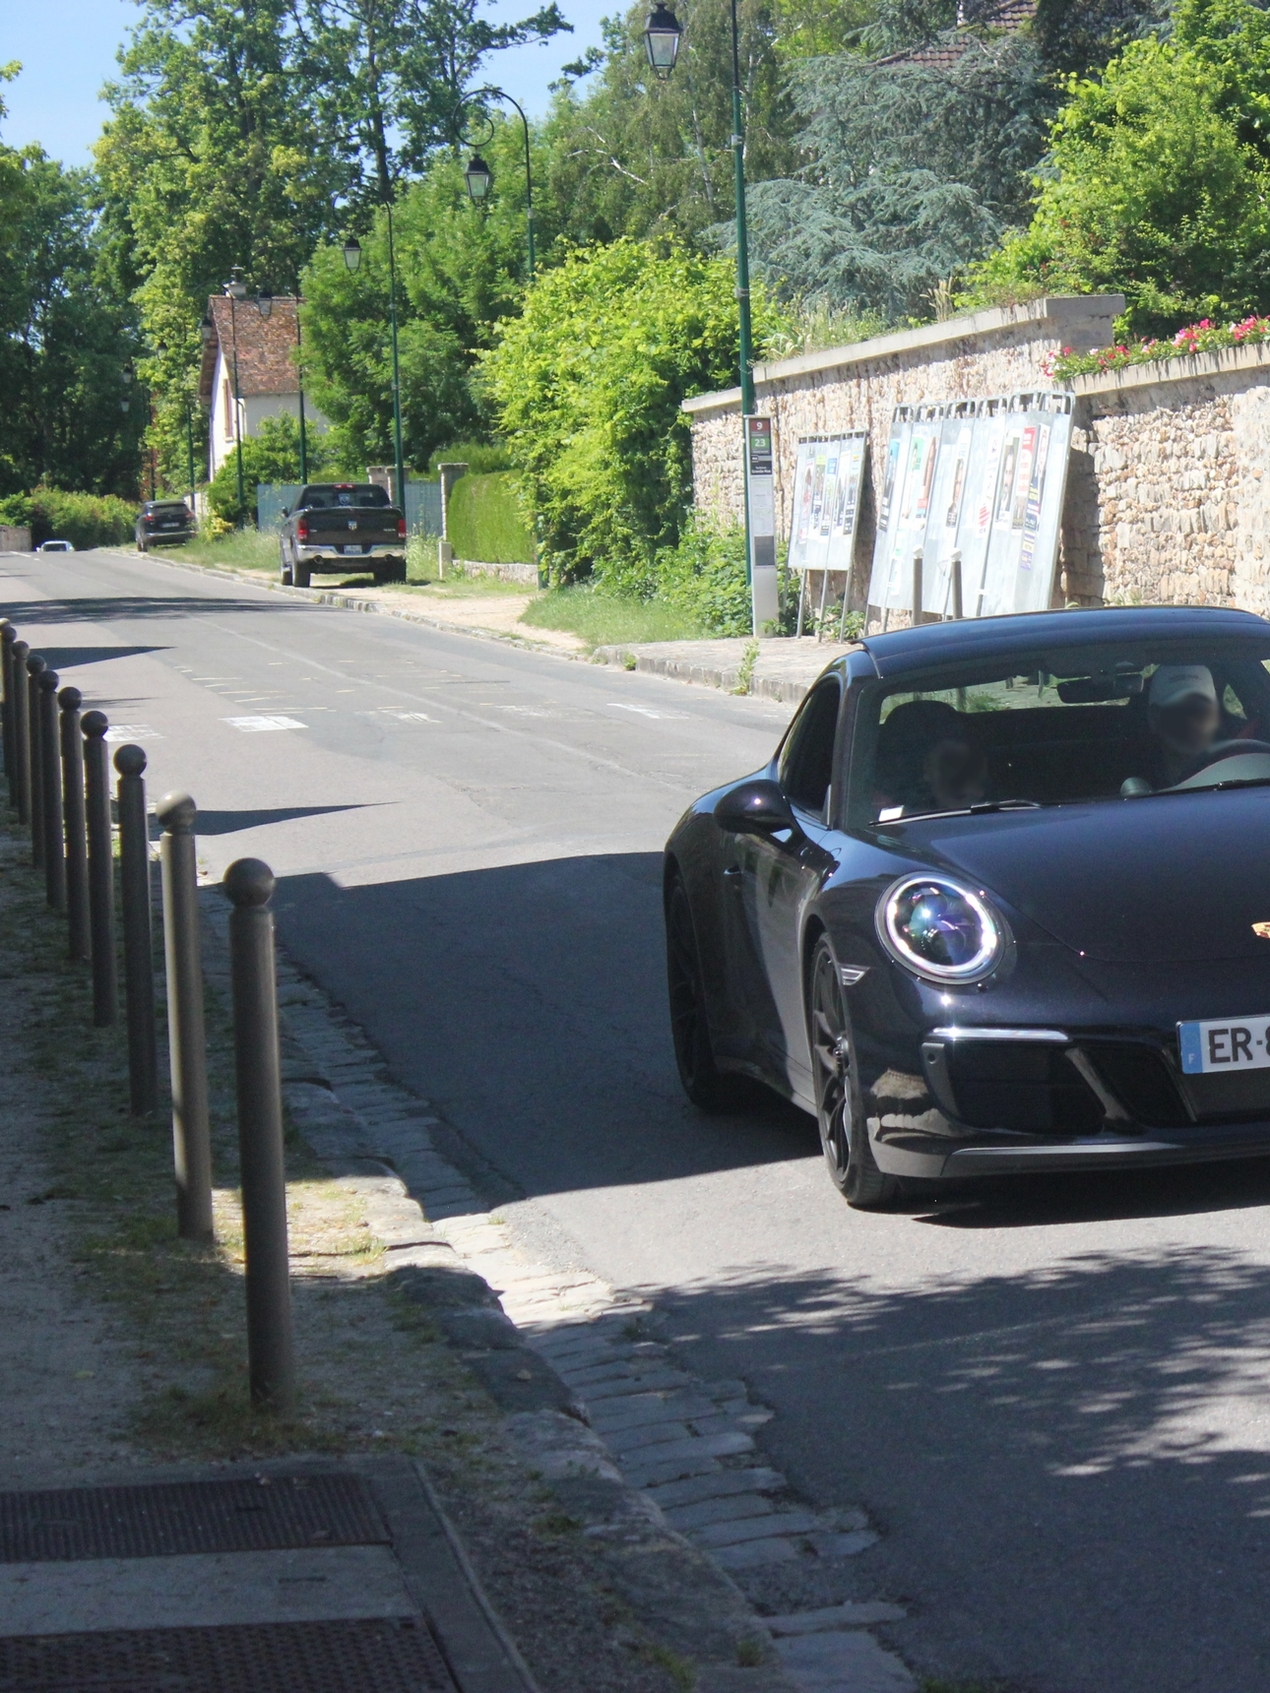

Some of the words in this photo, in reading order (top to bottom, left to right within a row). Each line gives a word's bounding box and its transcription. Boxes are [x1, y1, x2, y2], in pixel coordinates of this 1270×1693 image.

[756, 421, 763, 431] 9
[754, 438, 766, 447] 23
[1187, 1053, 1195, 1065] F
